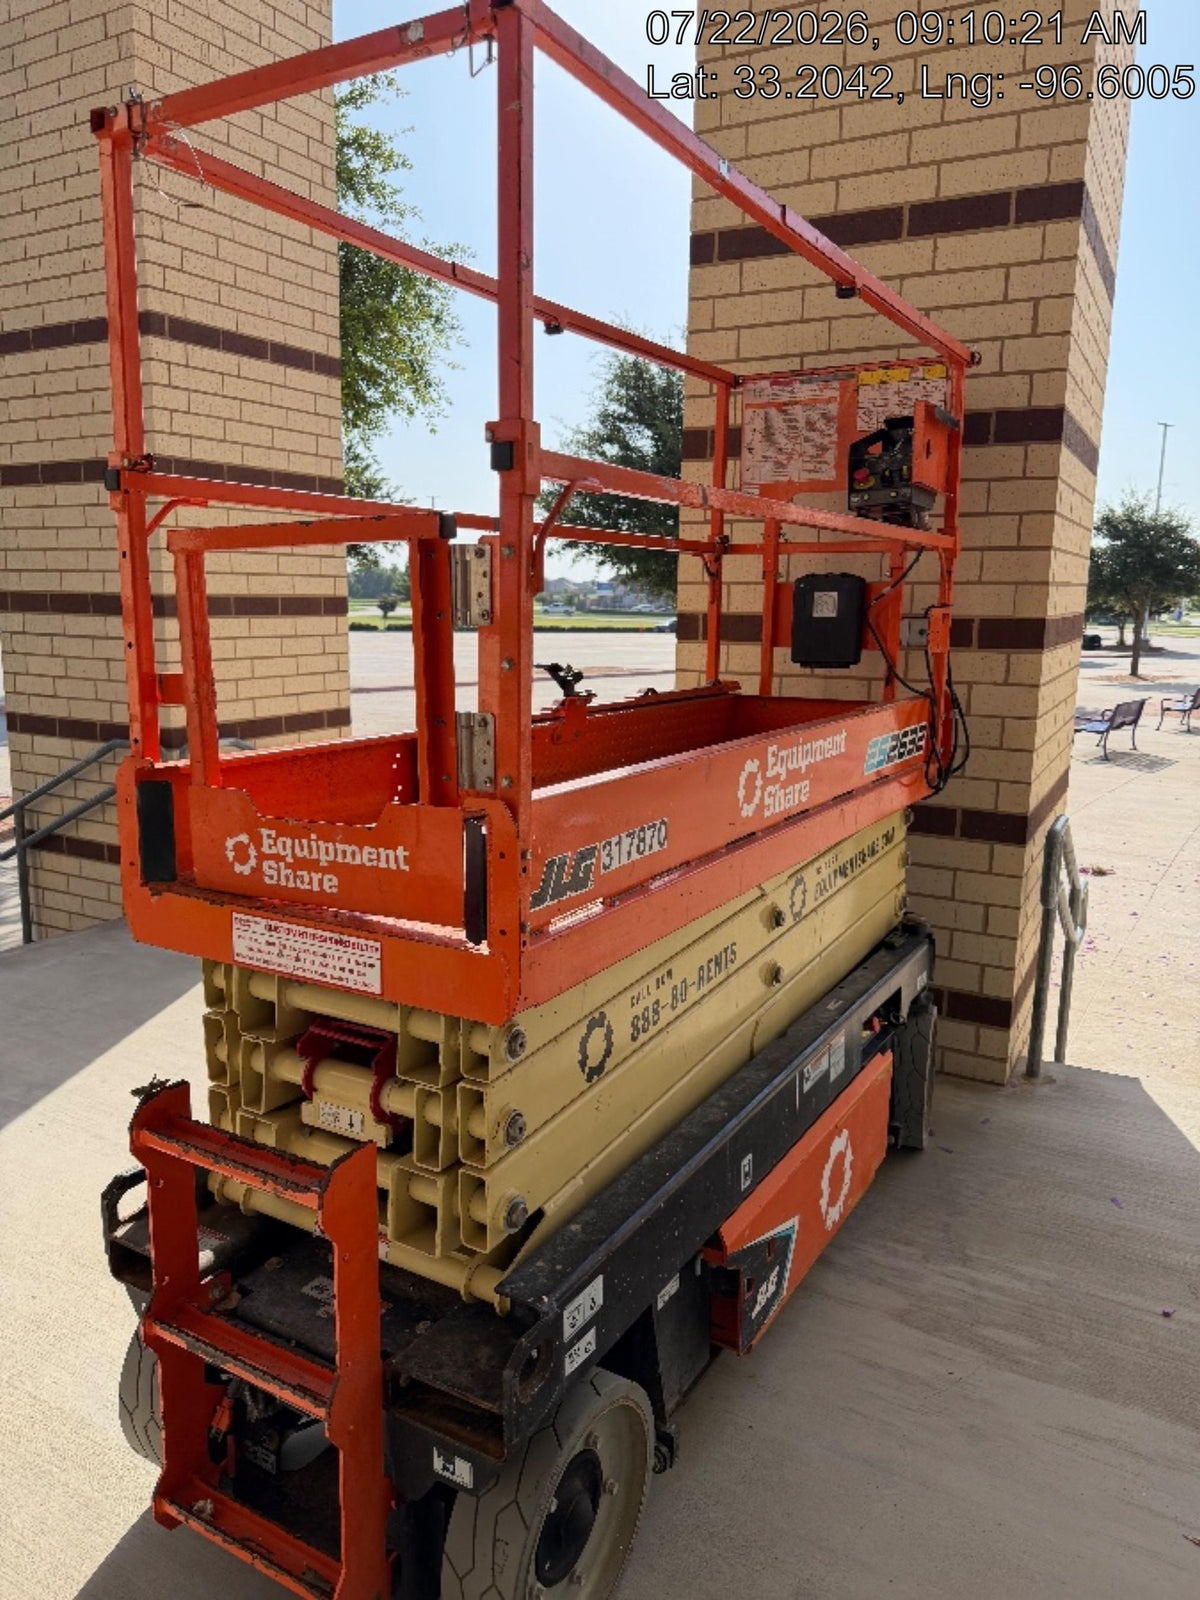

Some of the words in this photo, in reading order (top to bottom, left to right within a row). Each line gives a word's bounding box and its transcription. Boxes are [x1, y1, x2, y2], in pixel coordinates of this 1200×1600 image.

[766, 728, 847, 781] Equipment
[764, 780, 810, 818] Share
[258, 828, 410, 872] Equipment
[601, 817, 668, 873] 317870
[262, 860, 339, 894] Share
[529, 843, 599, 912] JLG
